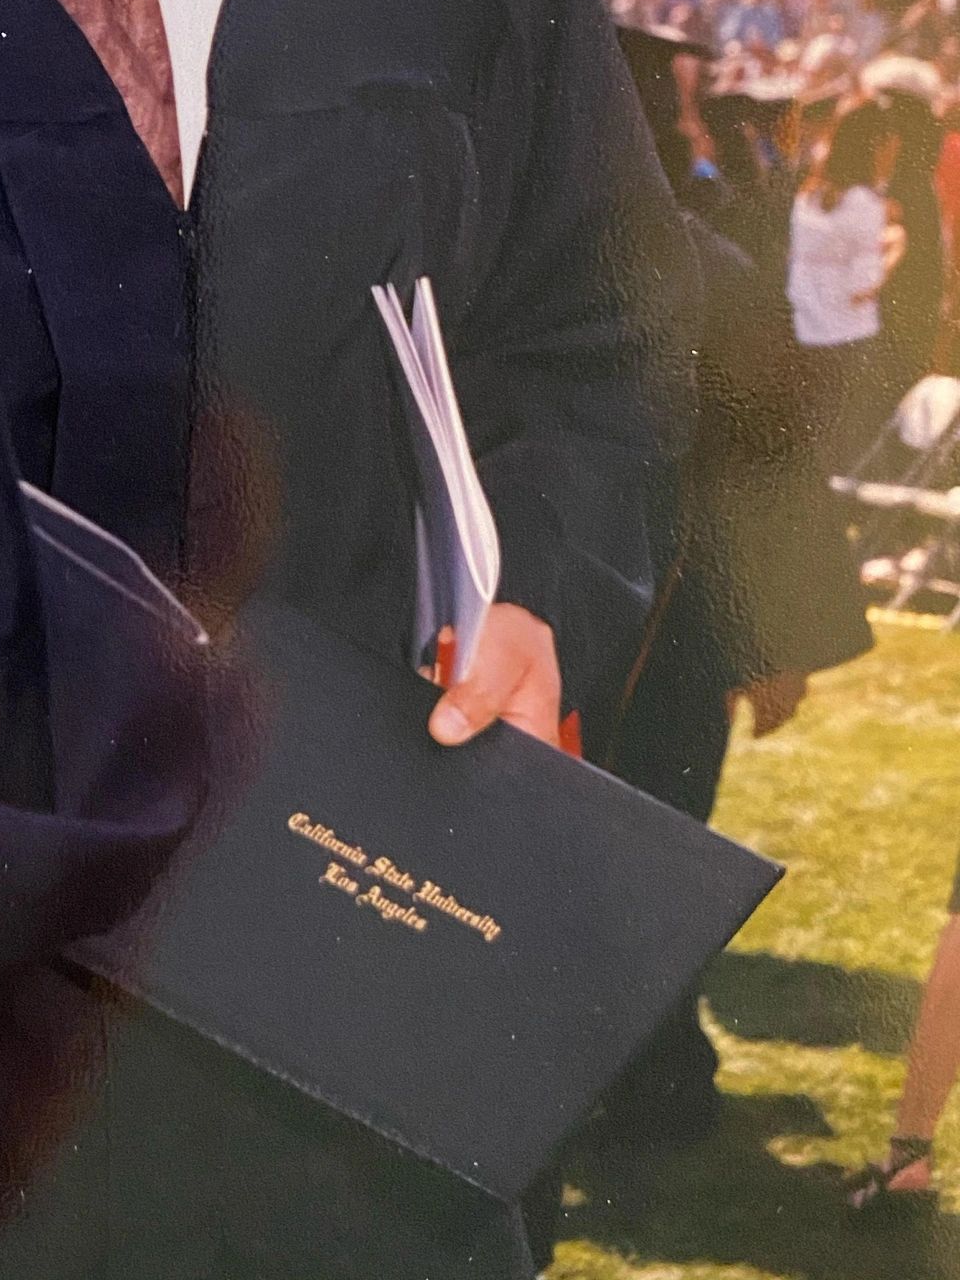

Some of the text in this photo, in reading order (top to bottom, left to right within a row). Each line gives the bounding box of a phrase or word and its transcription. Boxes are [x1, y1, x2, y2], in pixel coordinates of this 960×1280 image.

[288, 813, 501, 941] California State University
[318, 862, 427, 930] Los Angeles
